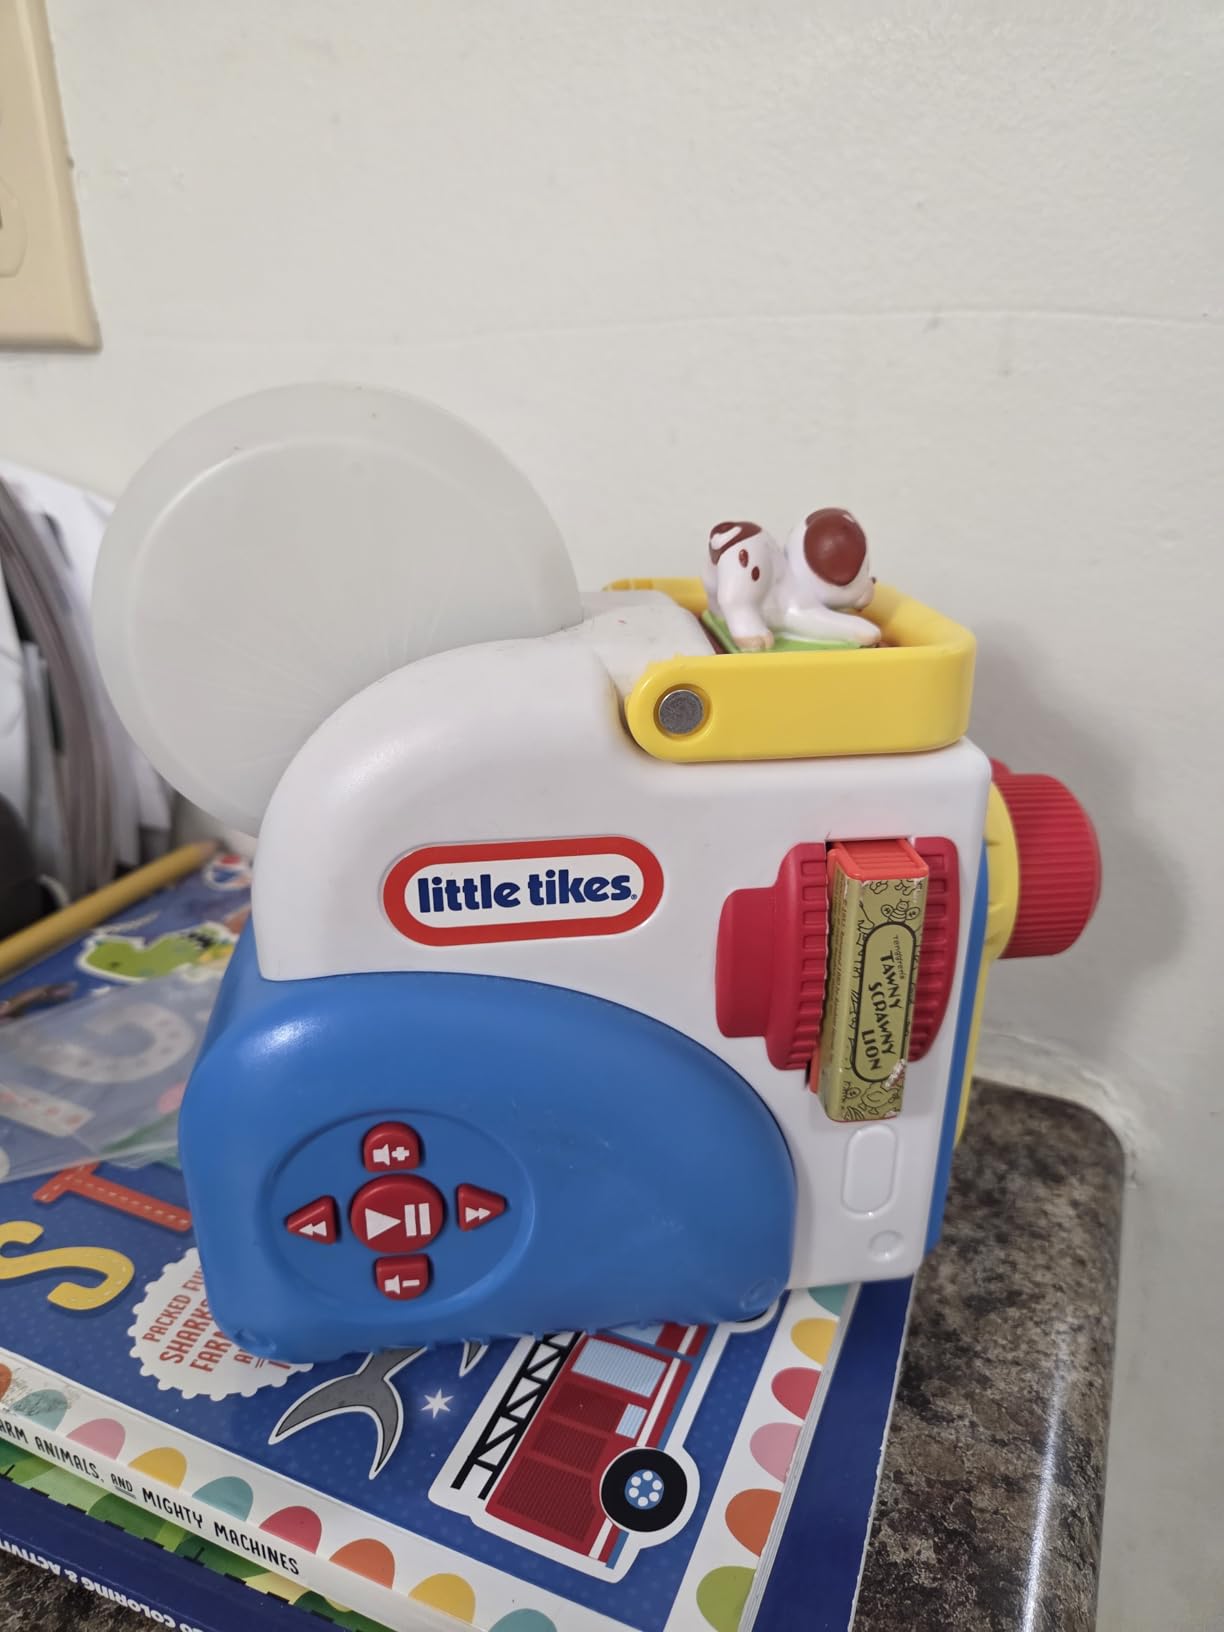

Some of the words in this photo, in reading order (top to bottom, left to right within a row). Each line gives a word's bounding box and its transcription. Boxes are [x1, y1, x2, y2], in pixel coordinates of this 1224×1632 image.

[417, 874, 521, 913] little
[880, 950, 902, 1009] TAWNY
[868, 981, 896, 1055] SCRAWNY
[861, 1029, 882, 1071] LION
[142, 1294, 192, 1343] PACKED
[0, 1419, 29, 1444] ARM
[110, 1473, 133, 1493] AND
[142, 1487, 203, 1529] MIGHTY
[213, 1521, 300, 1576] MACHINES
[64, 1568, 79, 1584] &
[80, 1576, 177, 1629] COLORING
